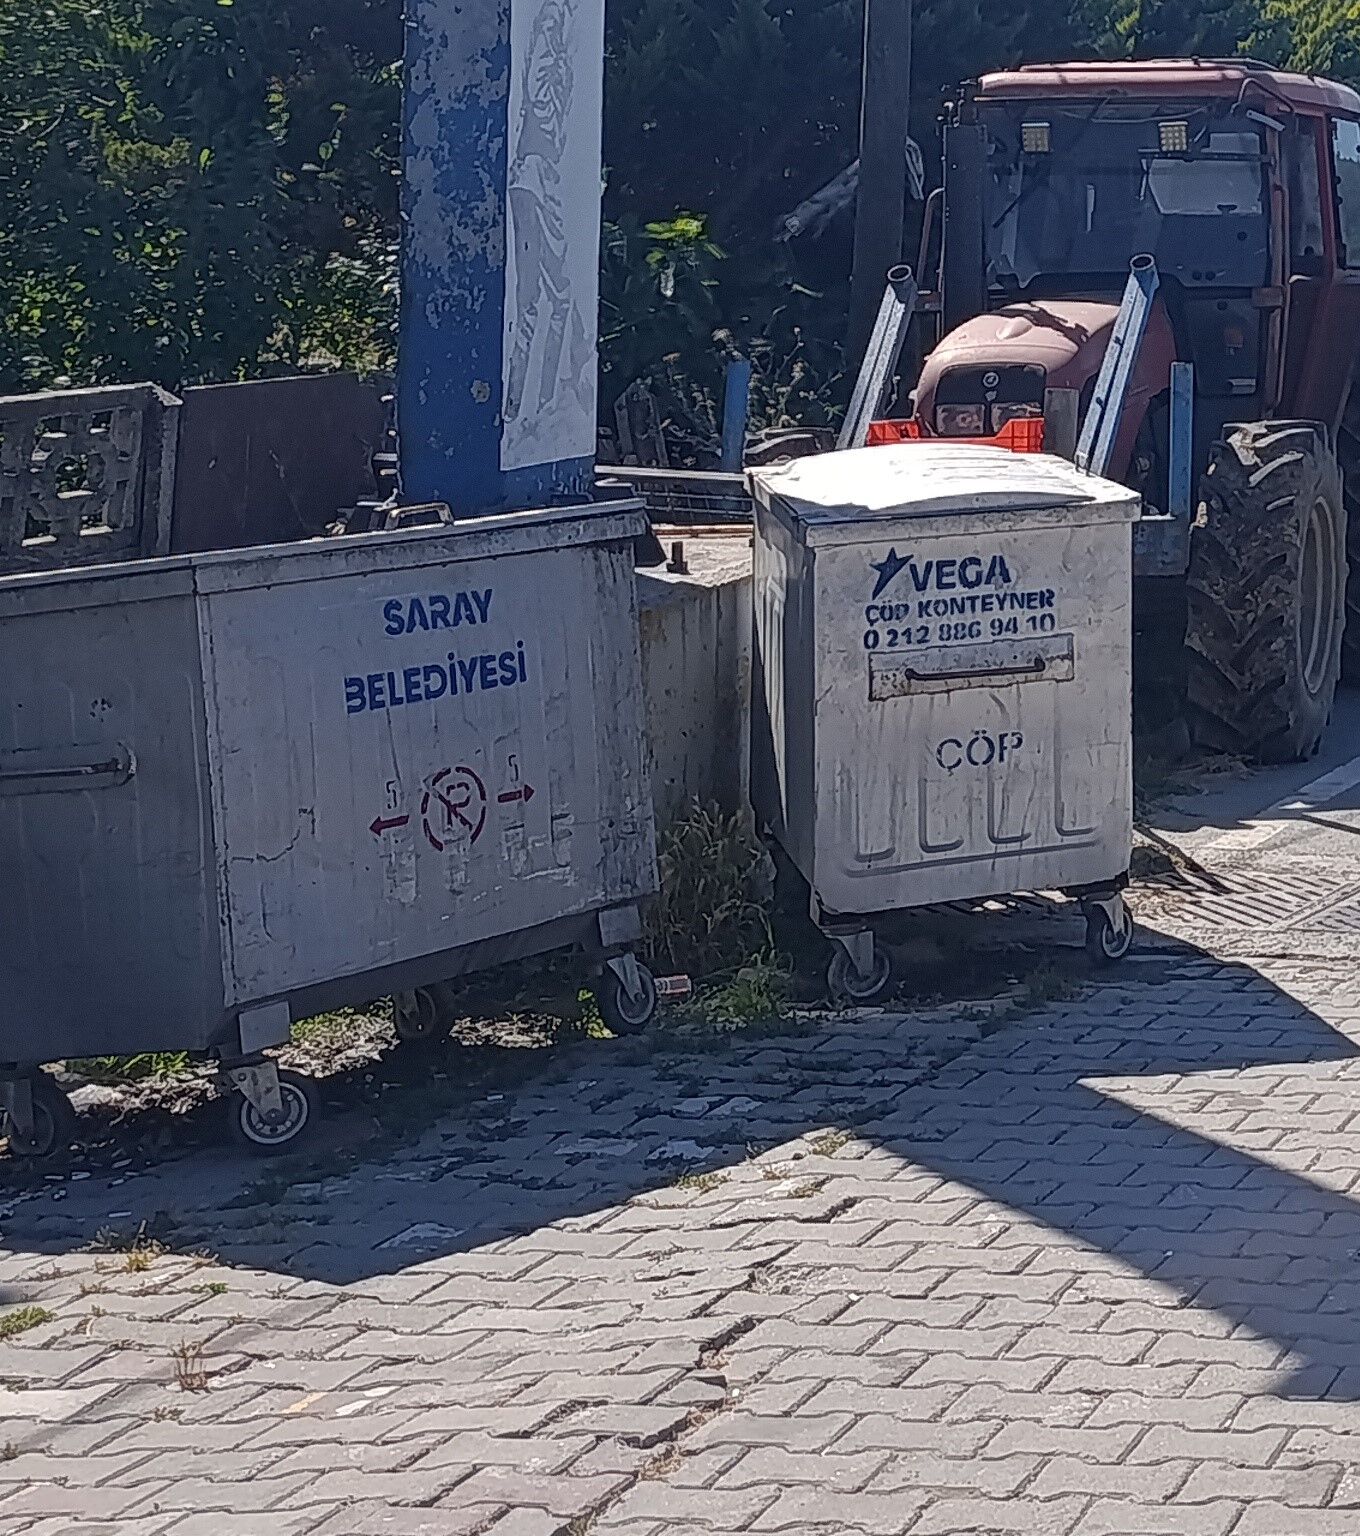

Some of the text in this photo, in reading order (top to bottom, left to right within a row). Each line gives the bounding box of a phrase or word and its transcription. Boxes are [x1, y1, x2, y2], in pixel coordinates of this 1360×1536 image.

[908, 555, 1012, 592] VEGA
[382, 588, 493, 636] SARAY
[917, 588, 1056, 619] KONTEYNER
[863, 629, 880, 650] 0
[886, 625, 931, 648] 212
[989, 616, 1019, 637] 94
[1026, 612, 1056, 632] 10
[344, 639, 528, 714] BELEDİYESİ
[936, 729, 1024, 777] ÇÖP
